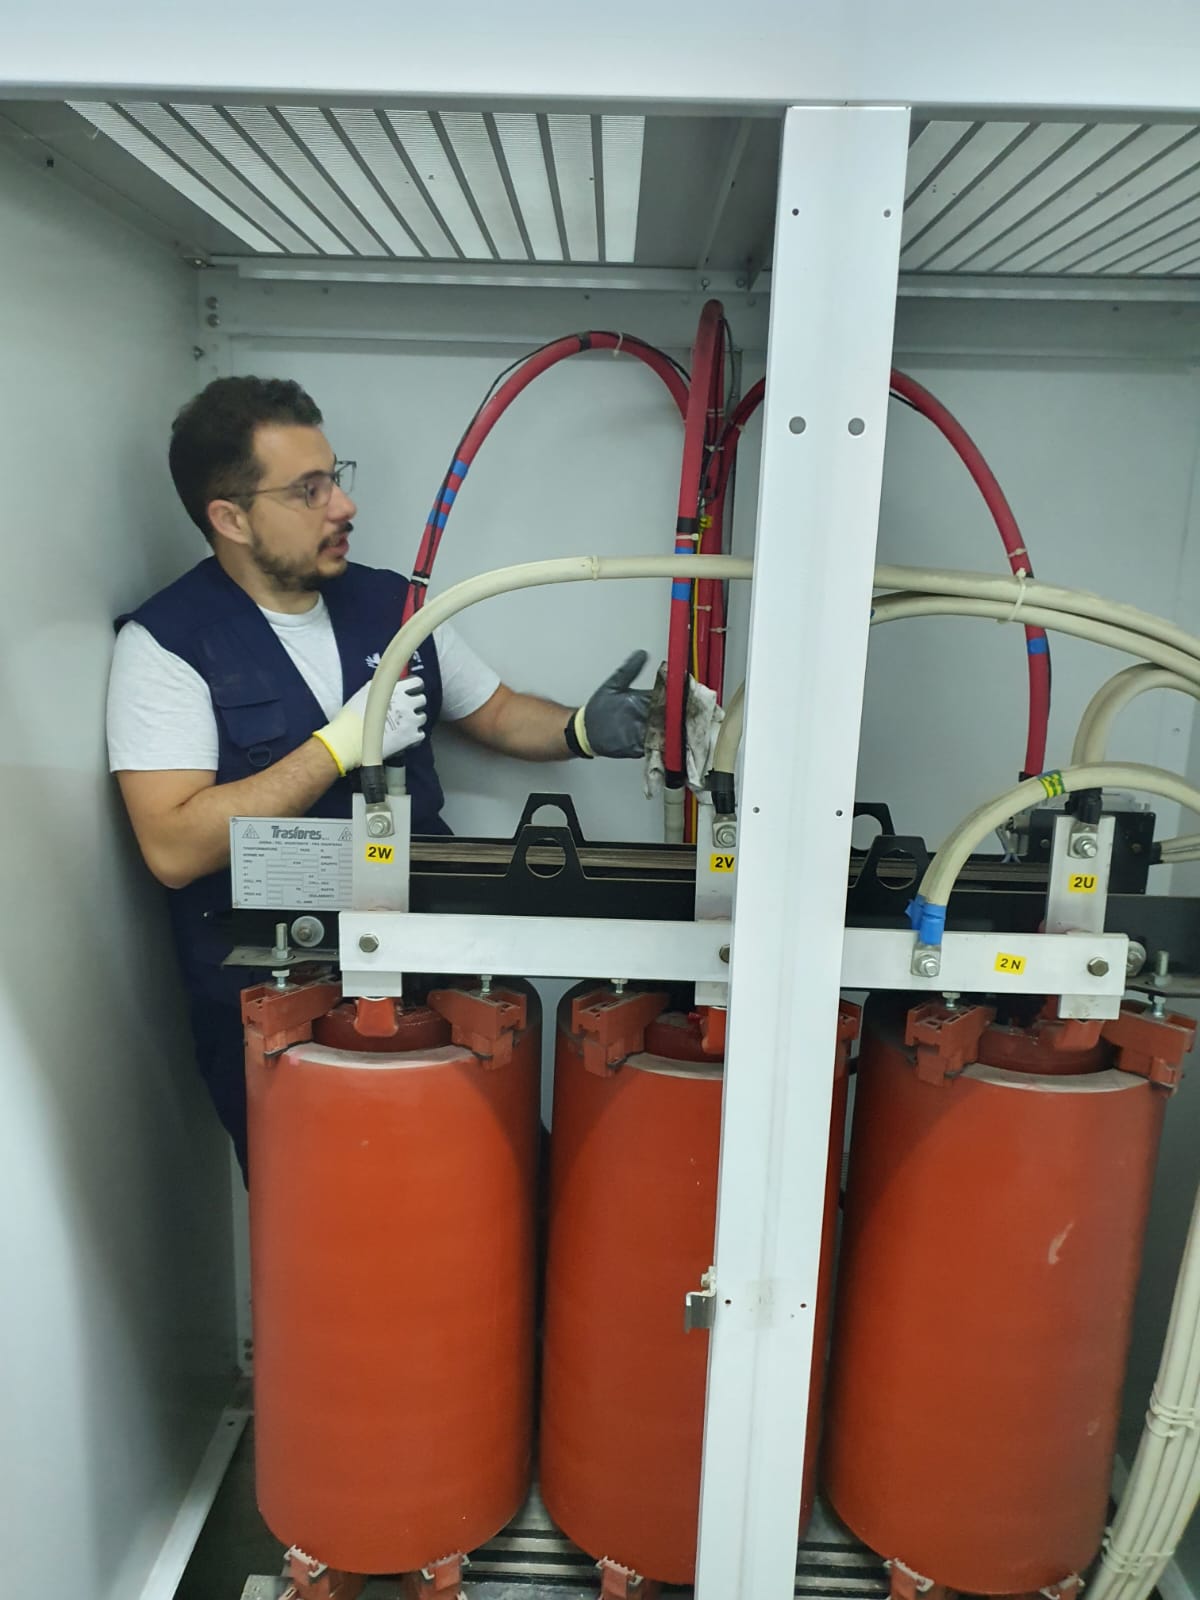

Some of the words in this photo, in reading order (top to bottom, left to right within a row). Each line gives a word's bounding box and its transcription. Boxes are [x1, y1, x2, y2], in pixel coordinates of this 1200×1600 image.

[271, 825, 322, 840] Trasfores
[368, 846, 392, 859] 2W
[715, 857, 734, 868] 2V
[1073, 876, 1094, 888] 2U
